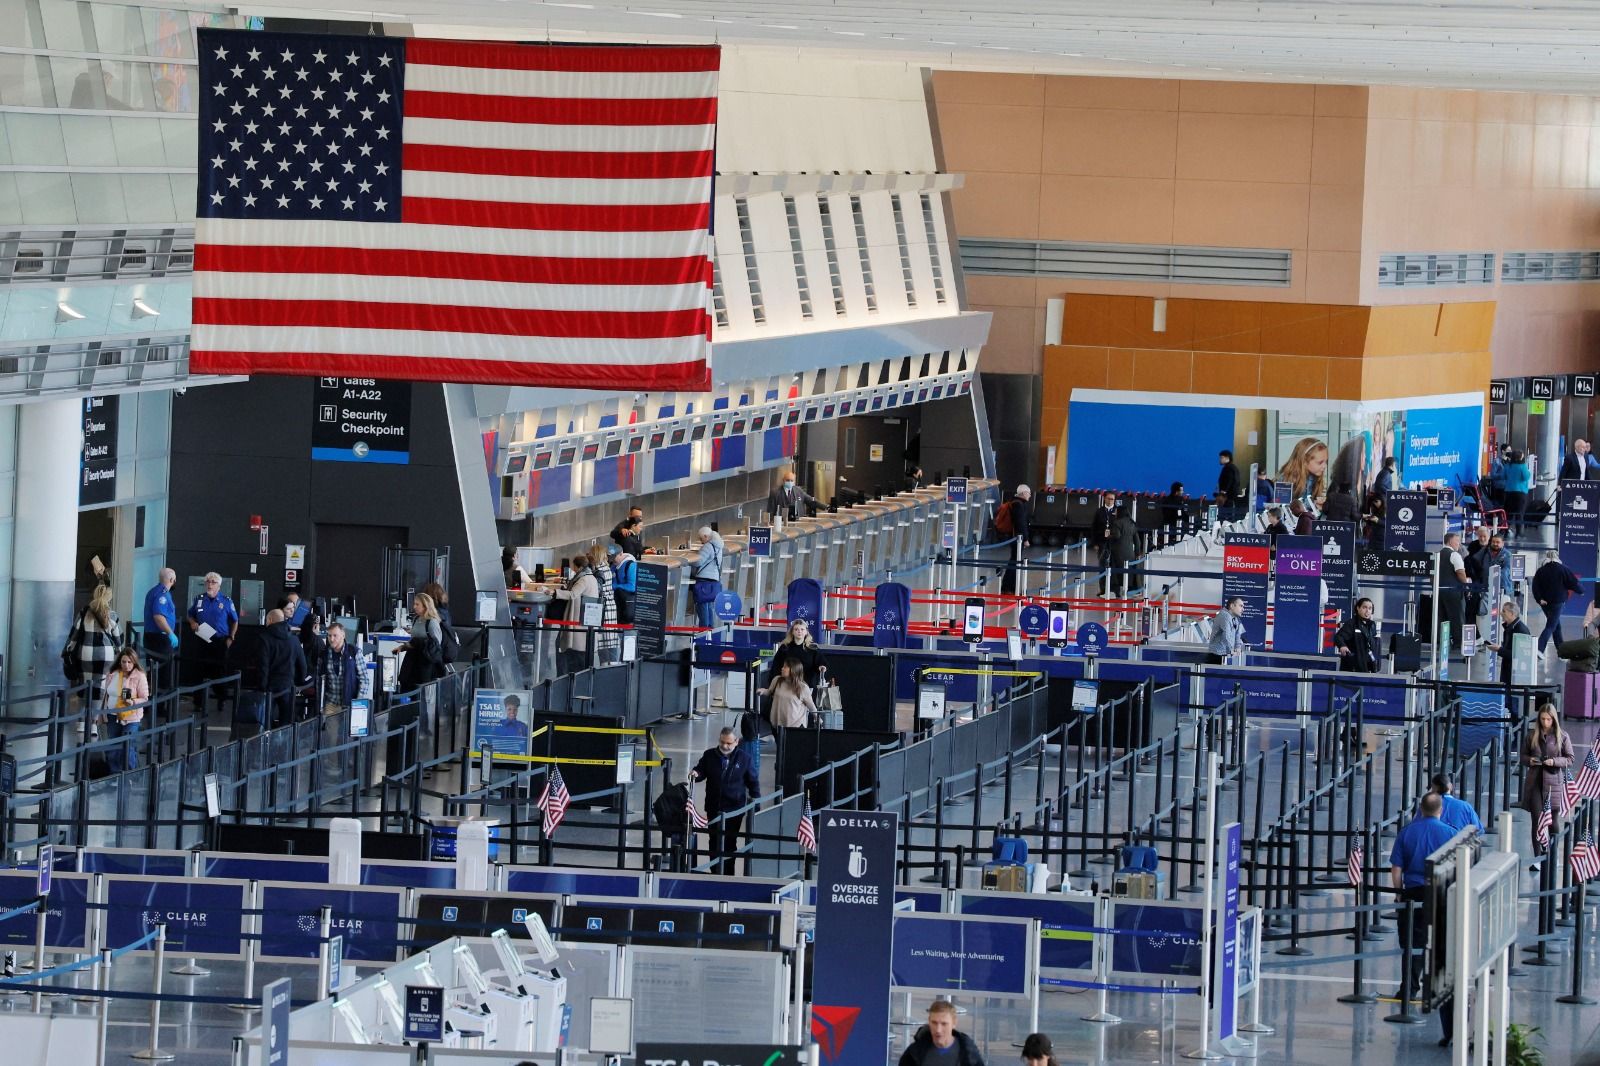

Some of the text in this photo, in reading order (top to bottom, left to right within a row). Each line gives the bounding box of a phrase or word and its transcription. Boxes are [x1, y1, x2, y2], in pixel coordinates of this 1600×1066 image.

[343, 377, 376, 386] Gates
[342, 389, 382, 400] A1-A22
[342, 408, 387, 423] Security
[341, 423, 404, 436] Checkpoint
[1403, 510, 1408, 519] 2
[751, 536, 768, 544] EXIT
[1291, 560, 1317, 570] ONE
[1386, 560, 1426, 569] CLEAR
[840, 819, 878, 828] DELTA
[832, 884, 878, 894] OVERSIZE
[832, 894, 878, 904] BAGGAGE
[167, 912, 206, 921] CLEAR
[329, 919, 362, 928] LEAR
[1173, 936, 1202, 945] CLEA
[926, 949, 950, 958] Waiting,
[968, 952, 1005, 962] Adventuring
